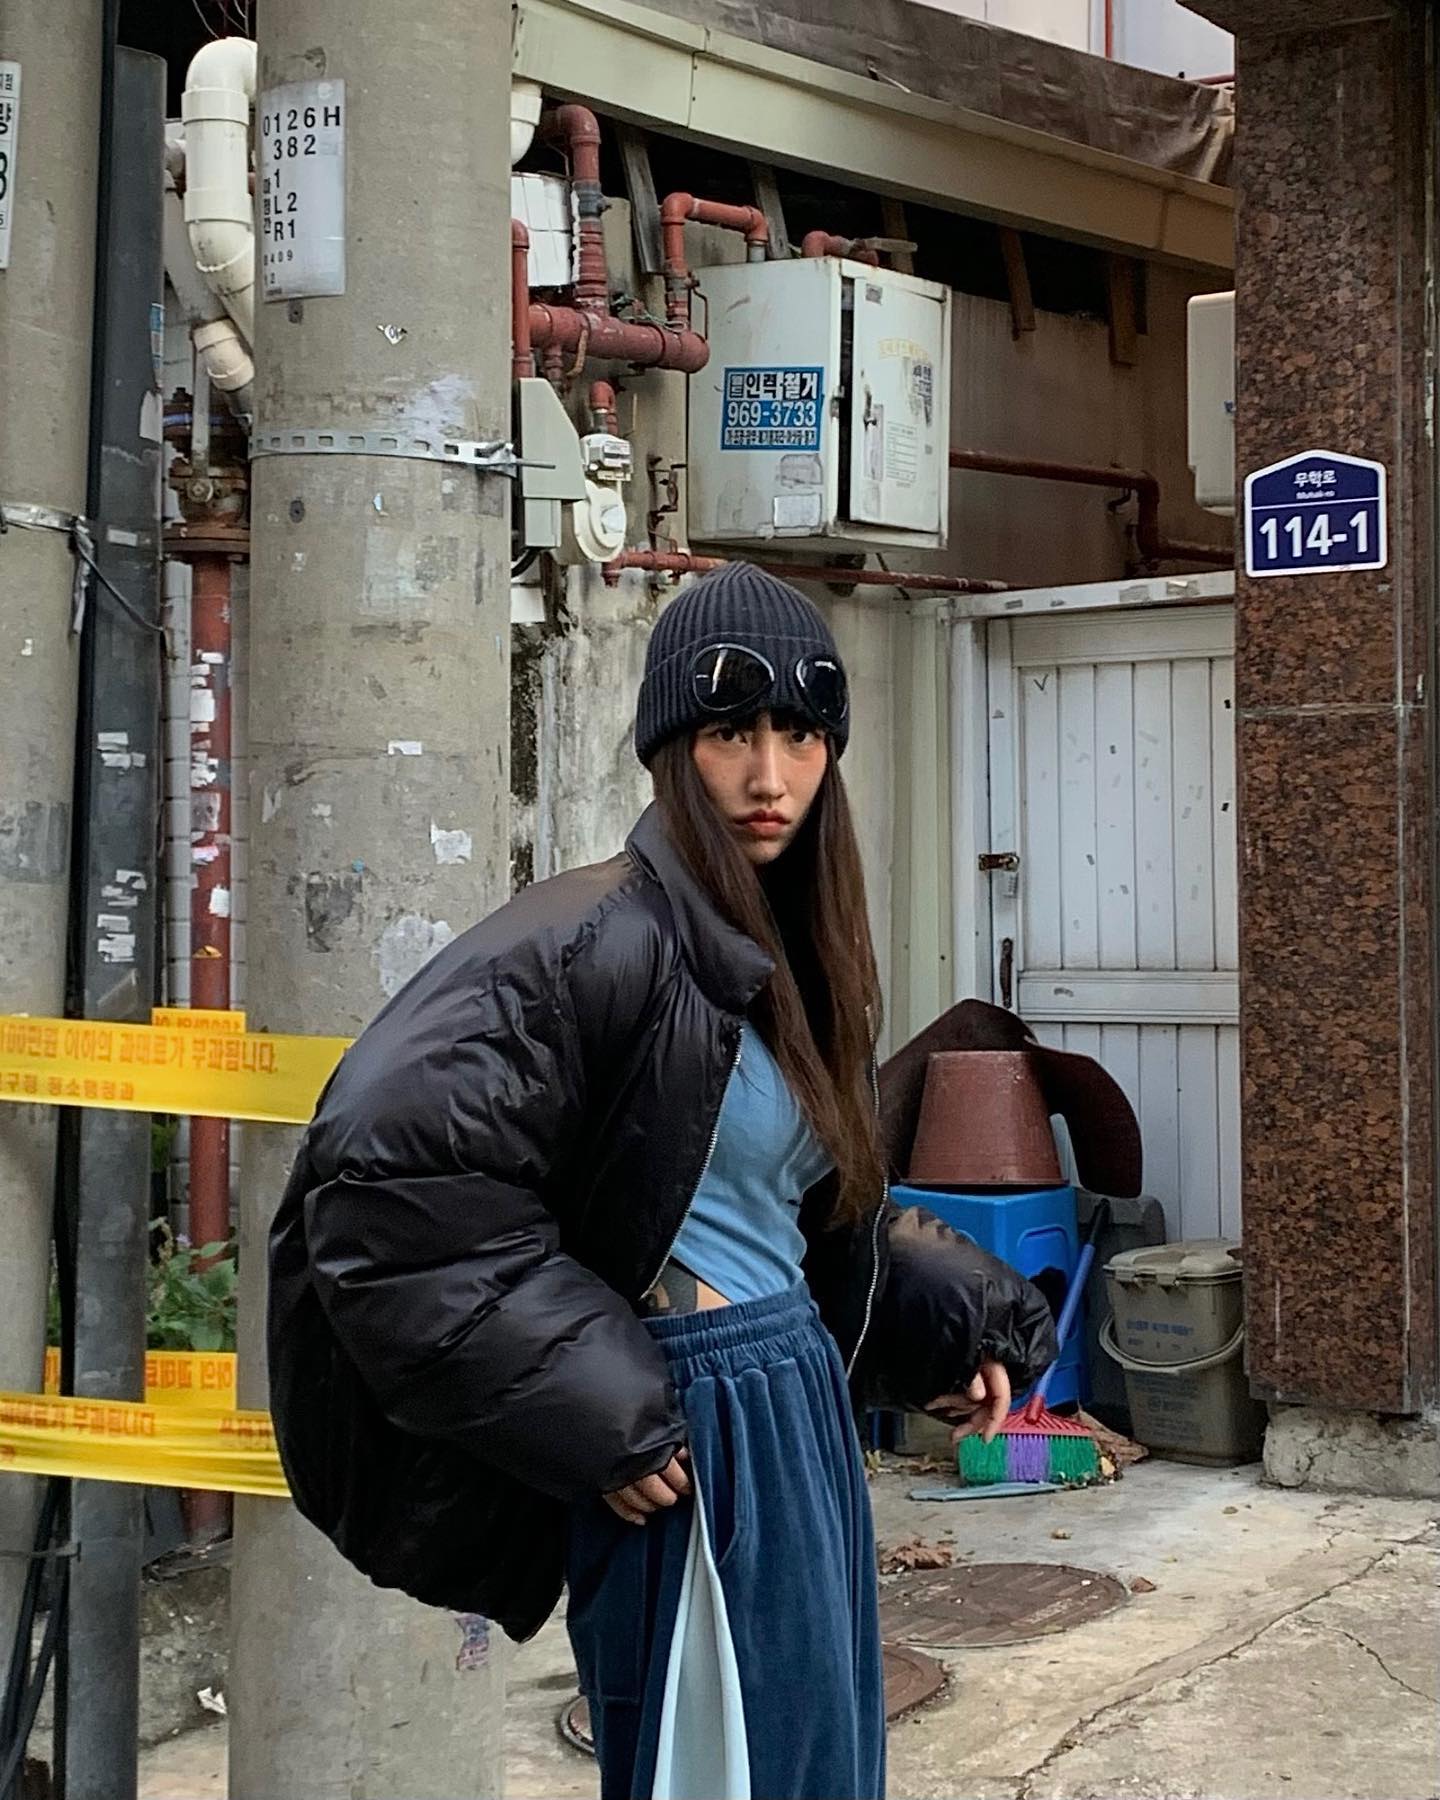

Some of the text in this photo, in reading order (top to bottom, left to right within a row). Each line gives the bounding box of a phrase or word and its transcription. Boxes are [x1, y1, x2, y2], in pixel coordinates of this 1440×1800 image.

[263, 106, 341, 136] 0126H
[273, 134, 316, 160] 382
[274, 192, 297, 215] L2
[274, 219, 296, 242] R1
[727, 401, 817, 426] 969-3733
[1259, 510, 1368, 559] 114-1
[0, 1072, 38, 1094] 구청
